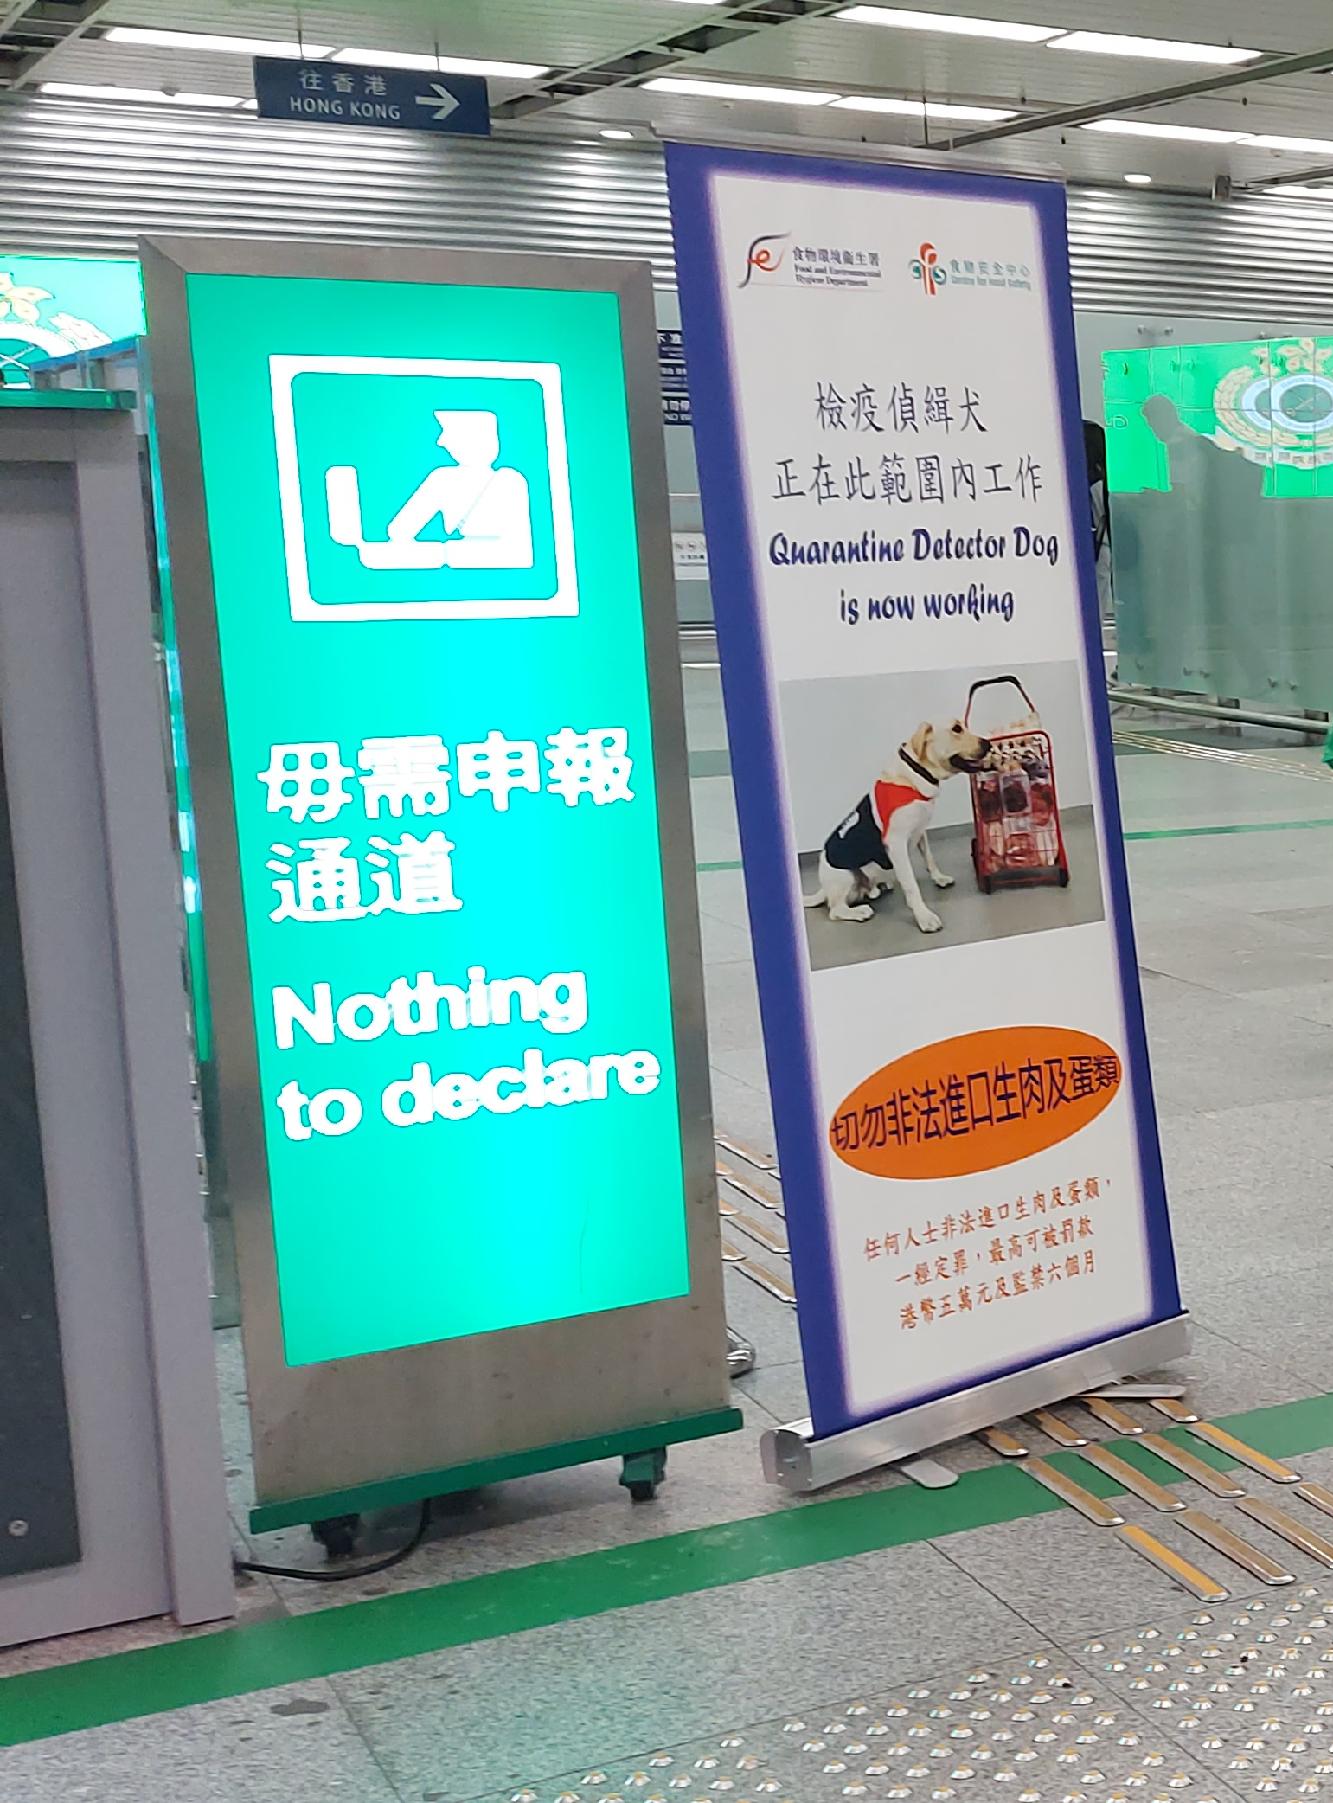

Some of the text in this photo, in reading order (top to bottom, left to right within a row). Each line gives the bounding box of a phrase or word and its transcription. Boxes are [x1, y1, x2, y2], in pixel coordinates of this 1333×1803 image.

[289, 96, 401, 120] HONG KONG
[299, 68, 388, 96] 往香港
[814, 381, 989, 434] 檢疫偵緝犬
[770, 451, 1043, 506] 正在此範圍內工作
[767, 525, 1059, 567] Quarantine Detector Dog
[839, 582, 1015, 626] is now working
[256, 726, 636, 824] 毋需申報
[265, 830, 464, 924] 通道
[271, 965, 589, 1050] Nothing
[276, 1048, 661, 1142] to declare
[830, 1054, 1120, 1151] 切勿非法進口生肉及蛋類
